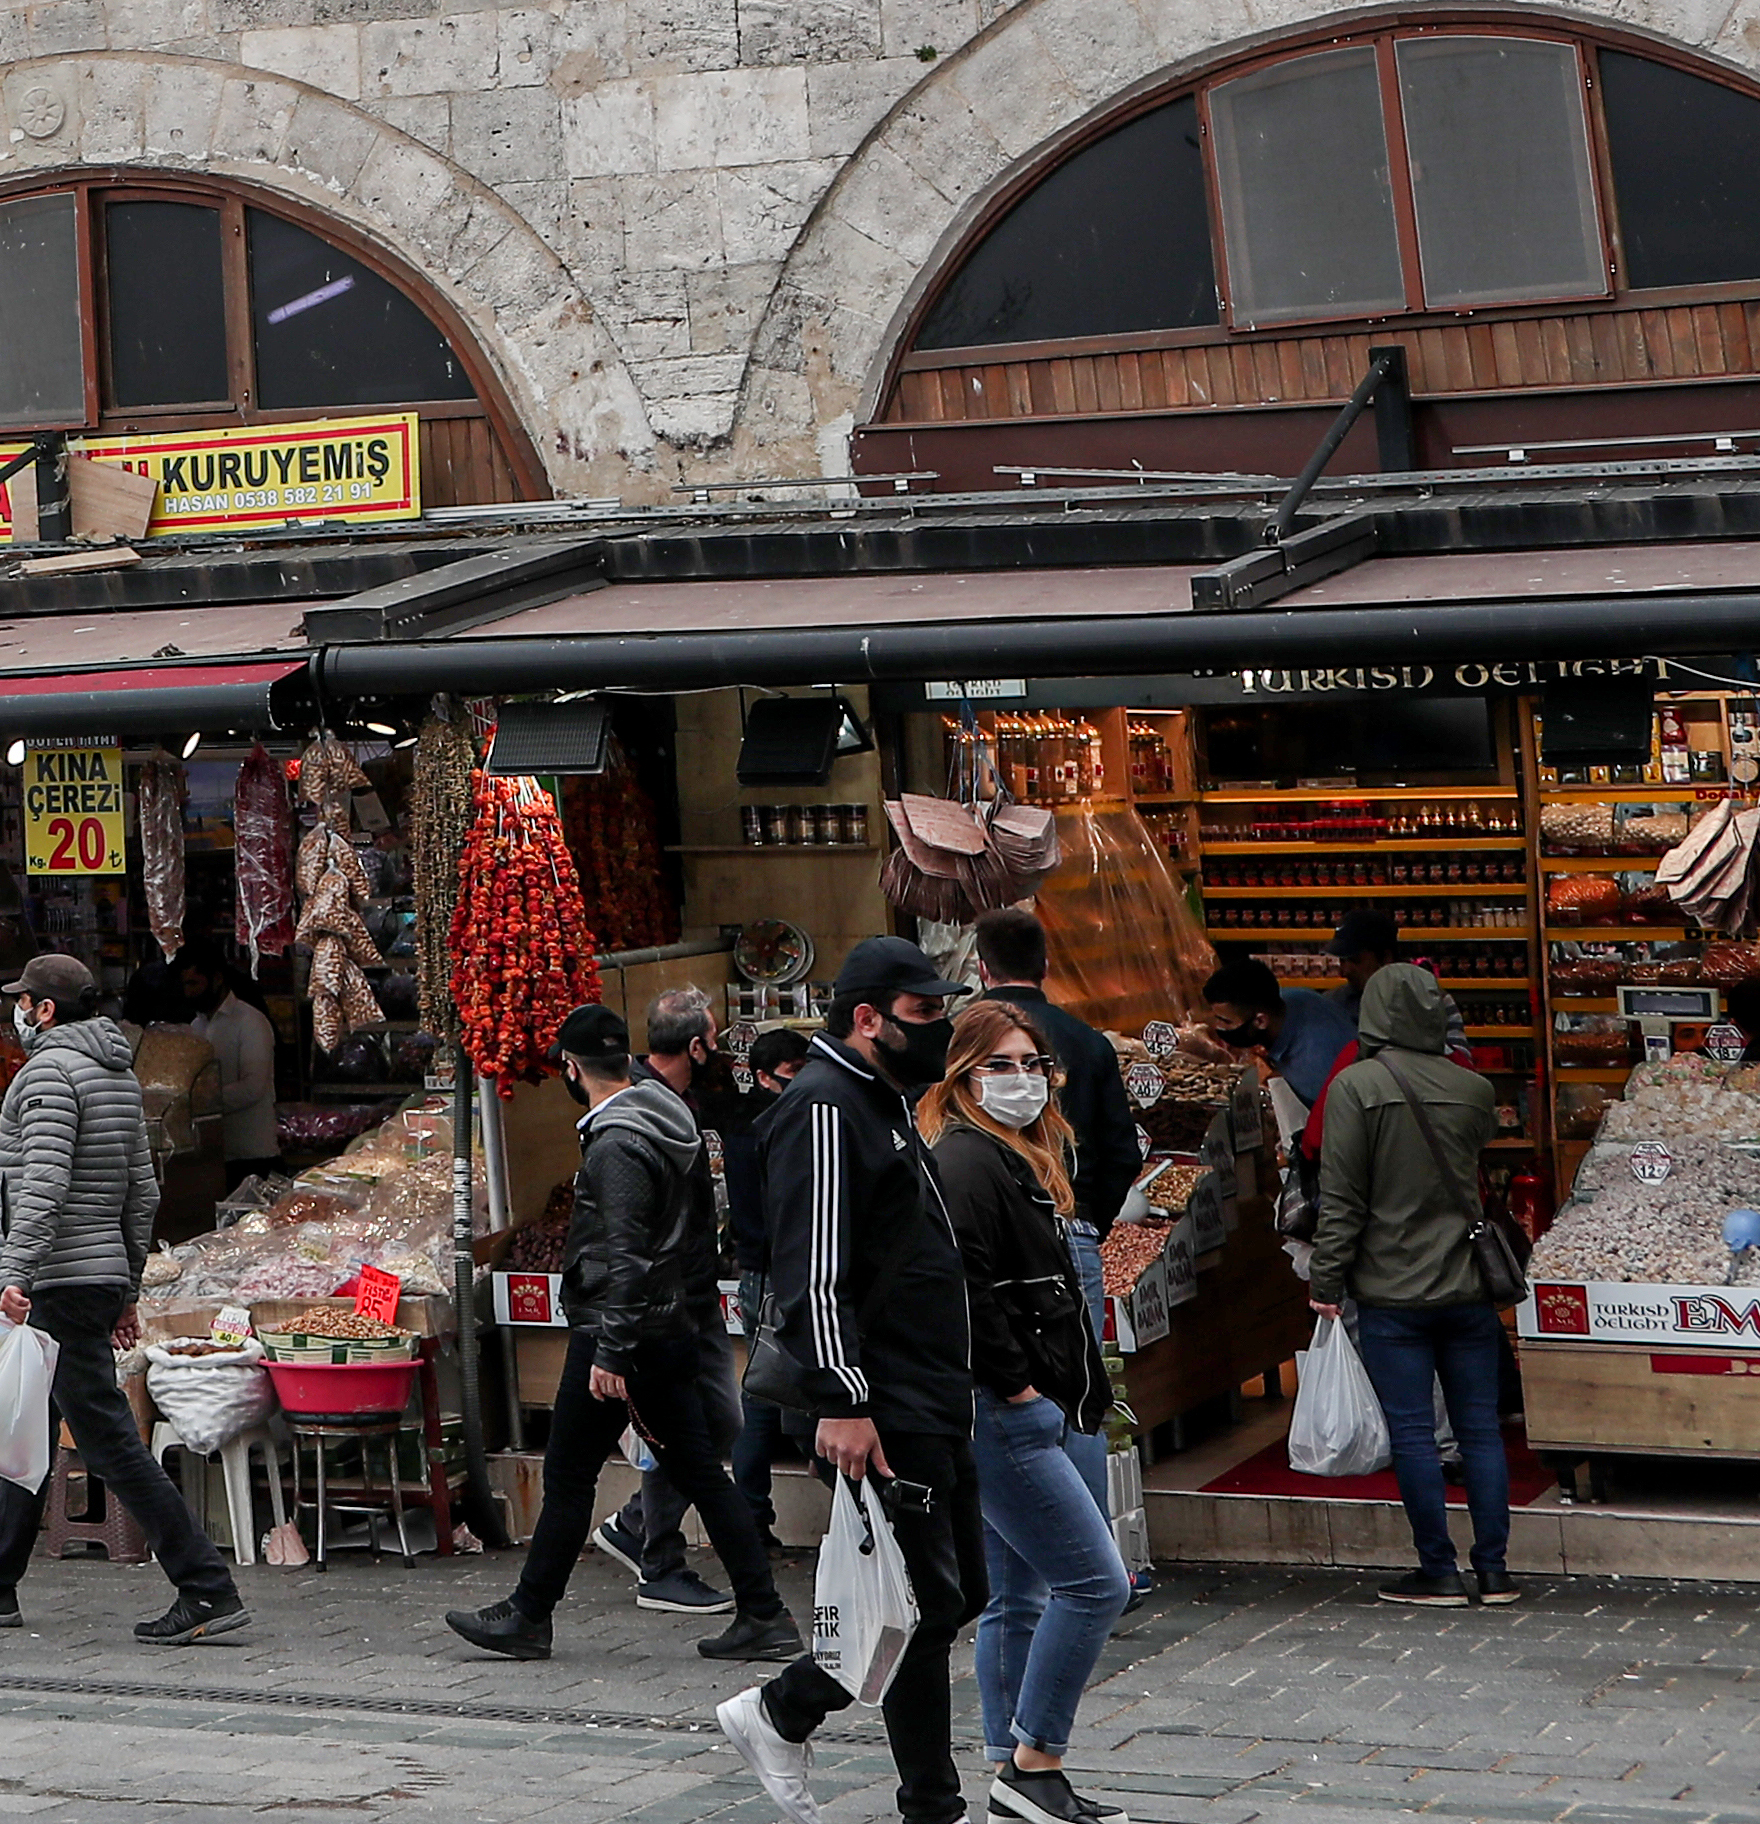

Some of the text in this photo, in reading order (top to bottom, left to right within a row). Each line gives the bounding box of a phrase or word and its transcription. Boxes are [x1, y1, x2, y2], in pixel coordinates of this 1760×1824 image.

[162, 439, 390, 494] KURUYEMiŞ
[164, 481, 372, 514] HASAN 0538 582 21 91
[36, 753, 108, 782] KINA
[27, 783, 120, 822] ÇEREZi
[48, 817, 105, 870] 20
[1641, 1166, 1655, 1177] 12
[360, 1296, 384, 1320] 85
[1593, 1303, 1669, 1318] TURKISH
[1594, 1315, 1669, 1331] DELIGHT
